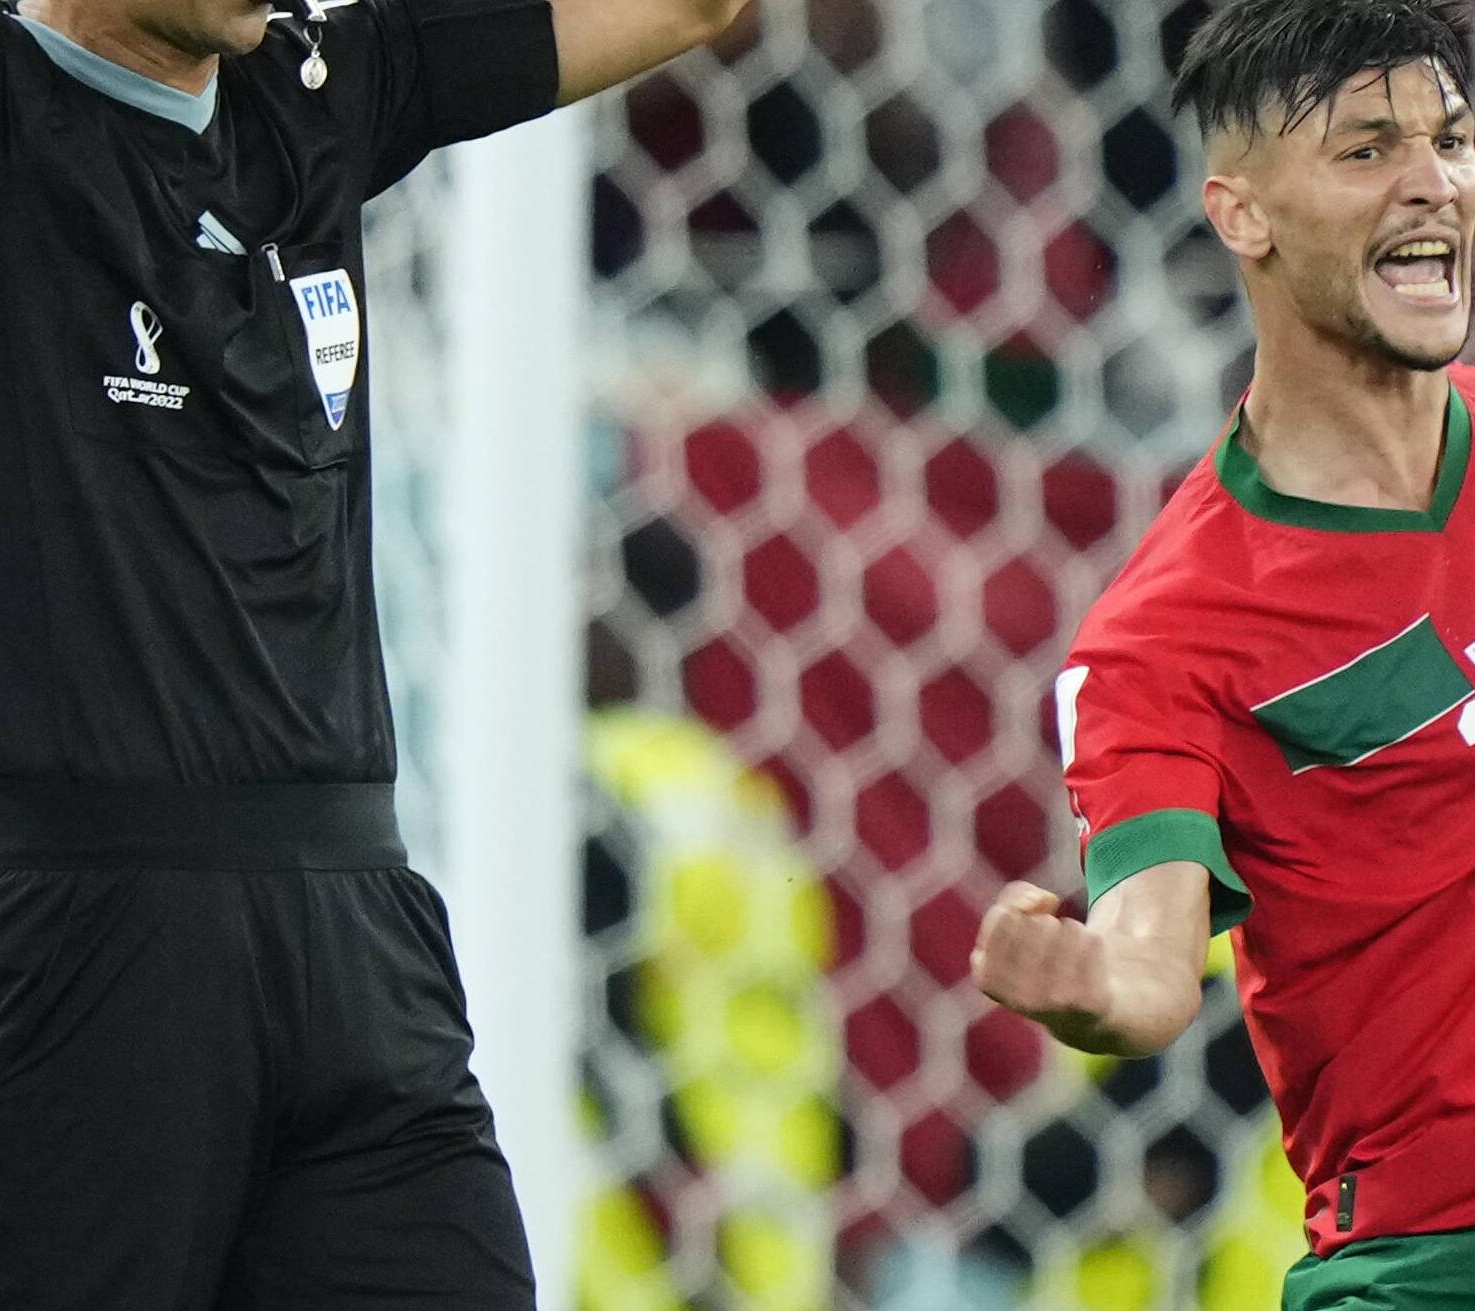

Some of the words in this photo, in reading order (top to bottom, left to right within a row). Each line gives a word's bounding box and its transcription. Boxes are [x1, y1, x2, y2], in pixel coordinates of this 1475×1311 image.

[302, 279, 351, 320] FIFA
[315, 341, 355, 365] REFEREE
[103, 375, 129, 388] FIFA
[129, 378, 167, 394] WORLD
[167, 384, 190, 397] CUP
